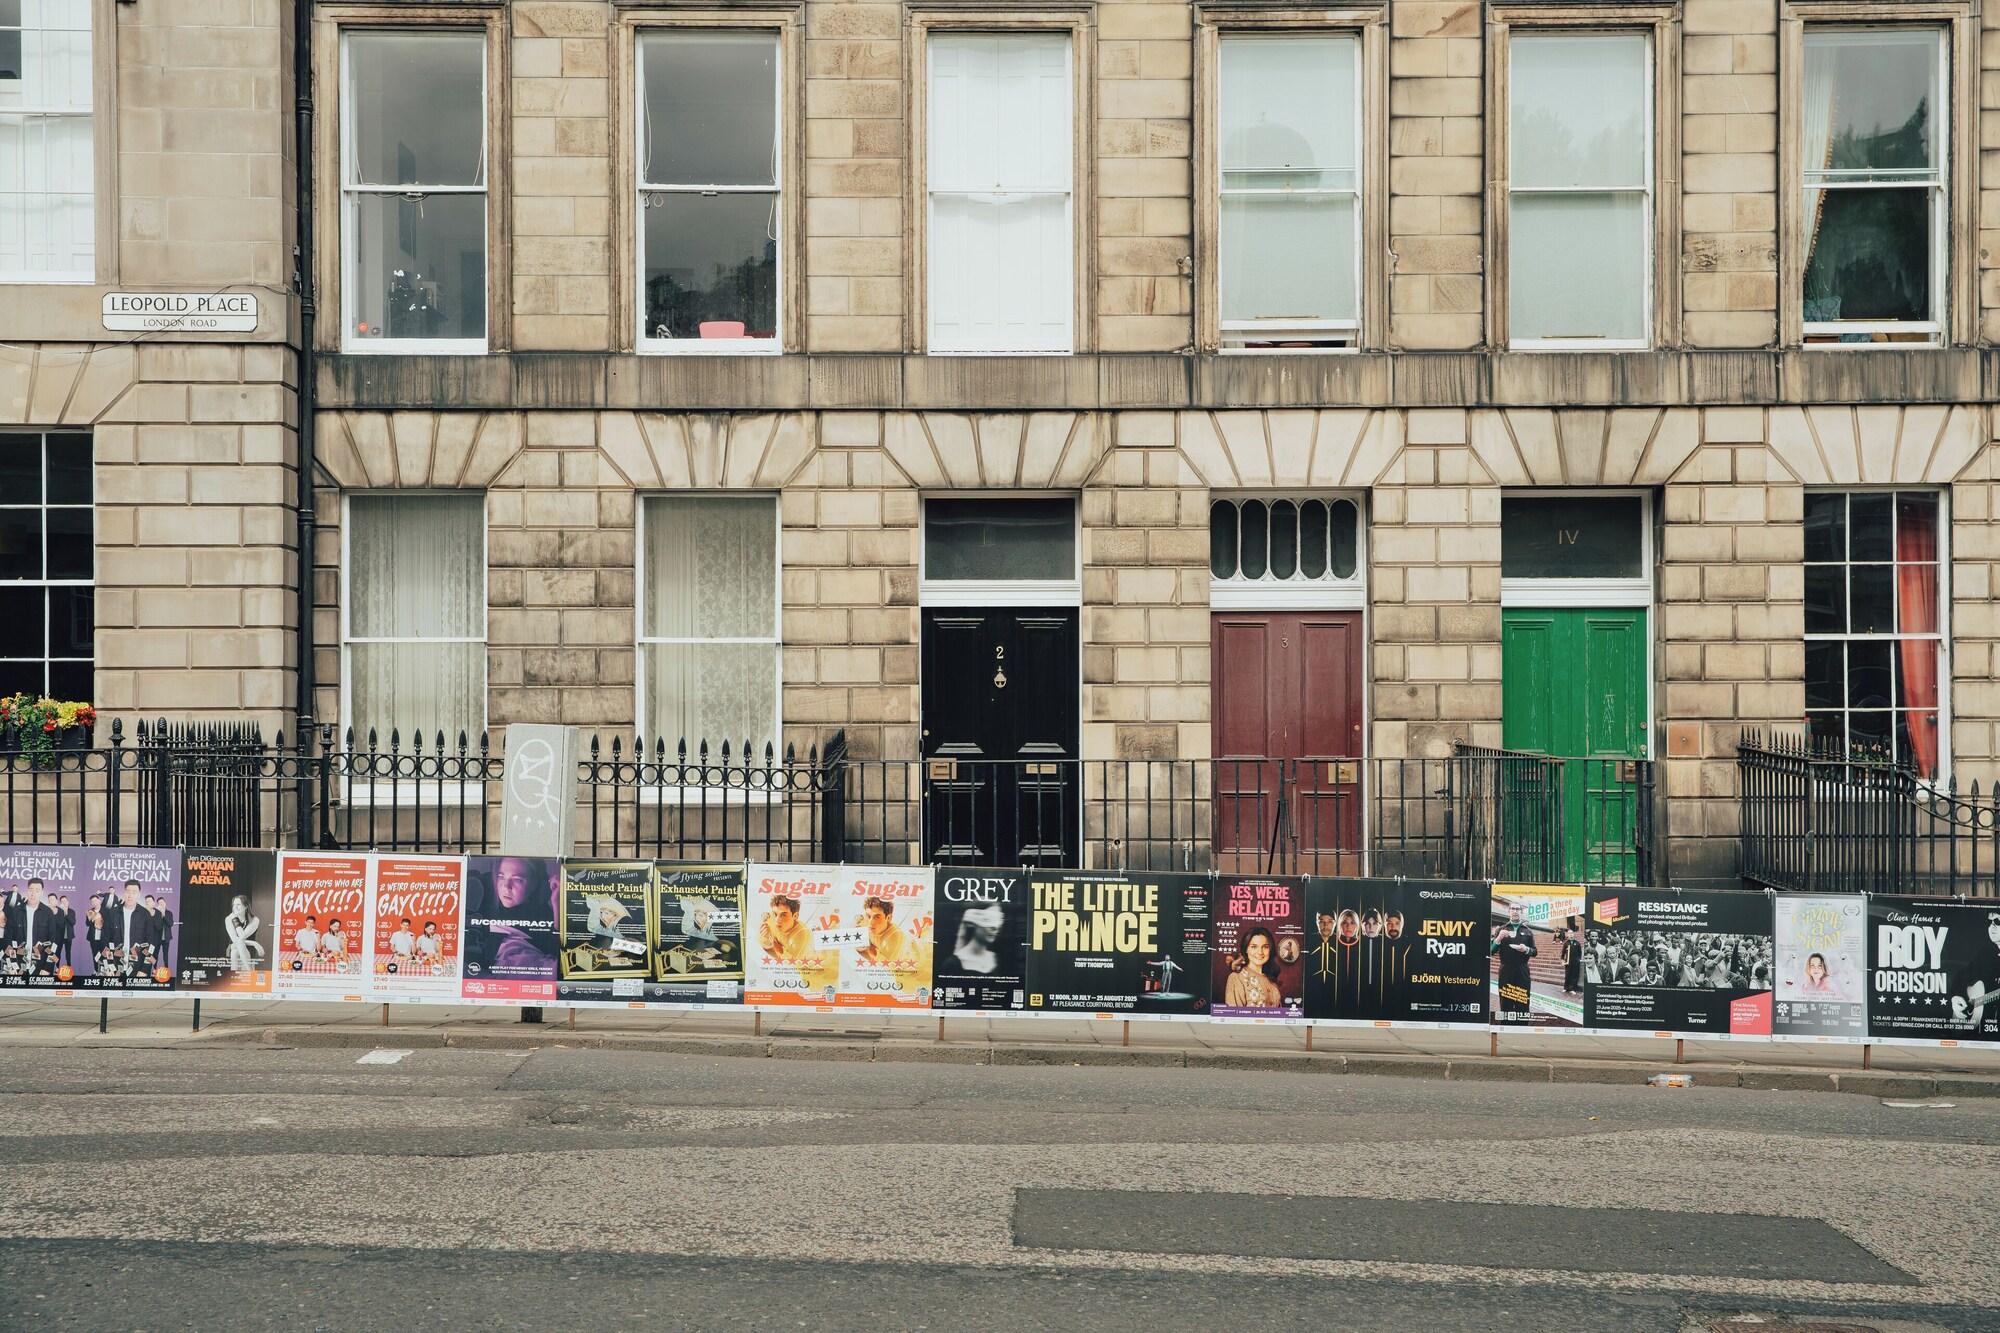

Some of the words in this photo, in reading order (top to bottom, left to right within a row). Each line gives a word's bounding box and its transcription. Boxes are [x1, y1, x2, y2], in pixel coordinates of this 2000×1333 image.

[111, 297, 188, 311] LEOPOLD
[198, 297, 249, 312] PLACE
[143, 319, 185, 327] LONDON
[190, 319, 217, 327] ROAD
[1558, 529, 1579, 545] IV
[1281, 637, 1289, 648] 3
[996, 646, 1004, 659] 2
[0, 857, 75, 868] MILLENNIAL
[94, 859, 172, 870] MILLENNIAL
[187, 861, 234, 871] WOMAN
[0, 868, 74, 880] MAGICIAN
[93, 870, 171, 882] MAGICIAN
[189, 875, 231, 885] ARENA
[586, 870, 609, 880] flying
[680, 872, 703, 882] flying
[292, 880, 313, 889] WEIRD
[315, 879, 333, 888] GUYS
[335, 879, 350, 888] WHO
[351, 878, 364, 888] ARE
[387, 882, 408, 891] WEIRD
[410, 882, 428, 891] GUYS
[429, 882, 445, 890] WHO
[446, 880, 459, 890] ARE
[566, 882, 614, 891] Exhausted
[660, 884, 708, 894] Exhausted
[758, 878, 832, 898] Sugar
[851, 879, 925, 900] Sugar
[944, 877, 1016, 902] GREY
[1031, 882, 1074, 910] THE
[1083, 883, 1158, 912] LITTLE
[1230, 885, 1253, 900] YES,
[1255, 886, 1290, 899] WE'RE
[1229, 899, 1290, 917] RELATED
[1528, 902, 1549, 915] ben
[1555, 899, 1572, 908] three
[1638, 902, 1708, 913] RESISTANCE
[1529, 912, 1549, 921] moor
[1550, 909, 1567, 918] thing
[1568, 905, 1579, 914] day
[471, 918, 554, 927] R/CONSPIRACY
[1887, 912, 1908, 922] Oliver
[1911, 913, 1933, 924] Harris
[1033, 910, 1158, 953] PRINCE
[1426, 938, 1466, 958] Ryan
[1878, 924, 1949, 969] ROY
[1411, 973, 1441, 983] BJÖRN
[1443, 975, 1481, 986] Yesterday
[1875, 970, 1947, 994] ORBISON
[1449, 1003, 1470, 1012] 17:30
[1984, 1024, 1998, 1032] 304
